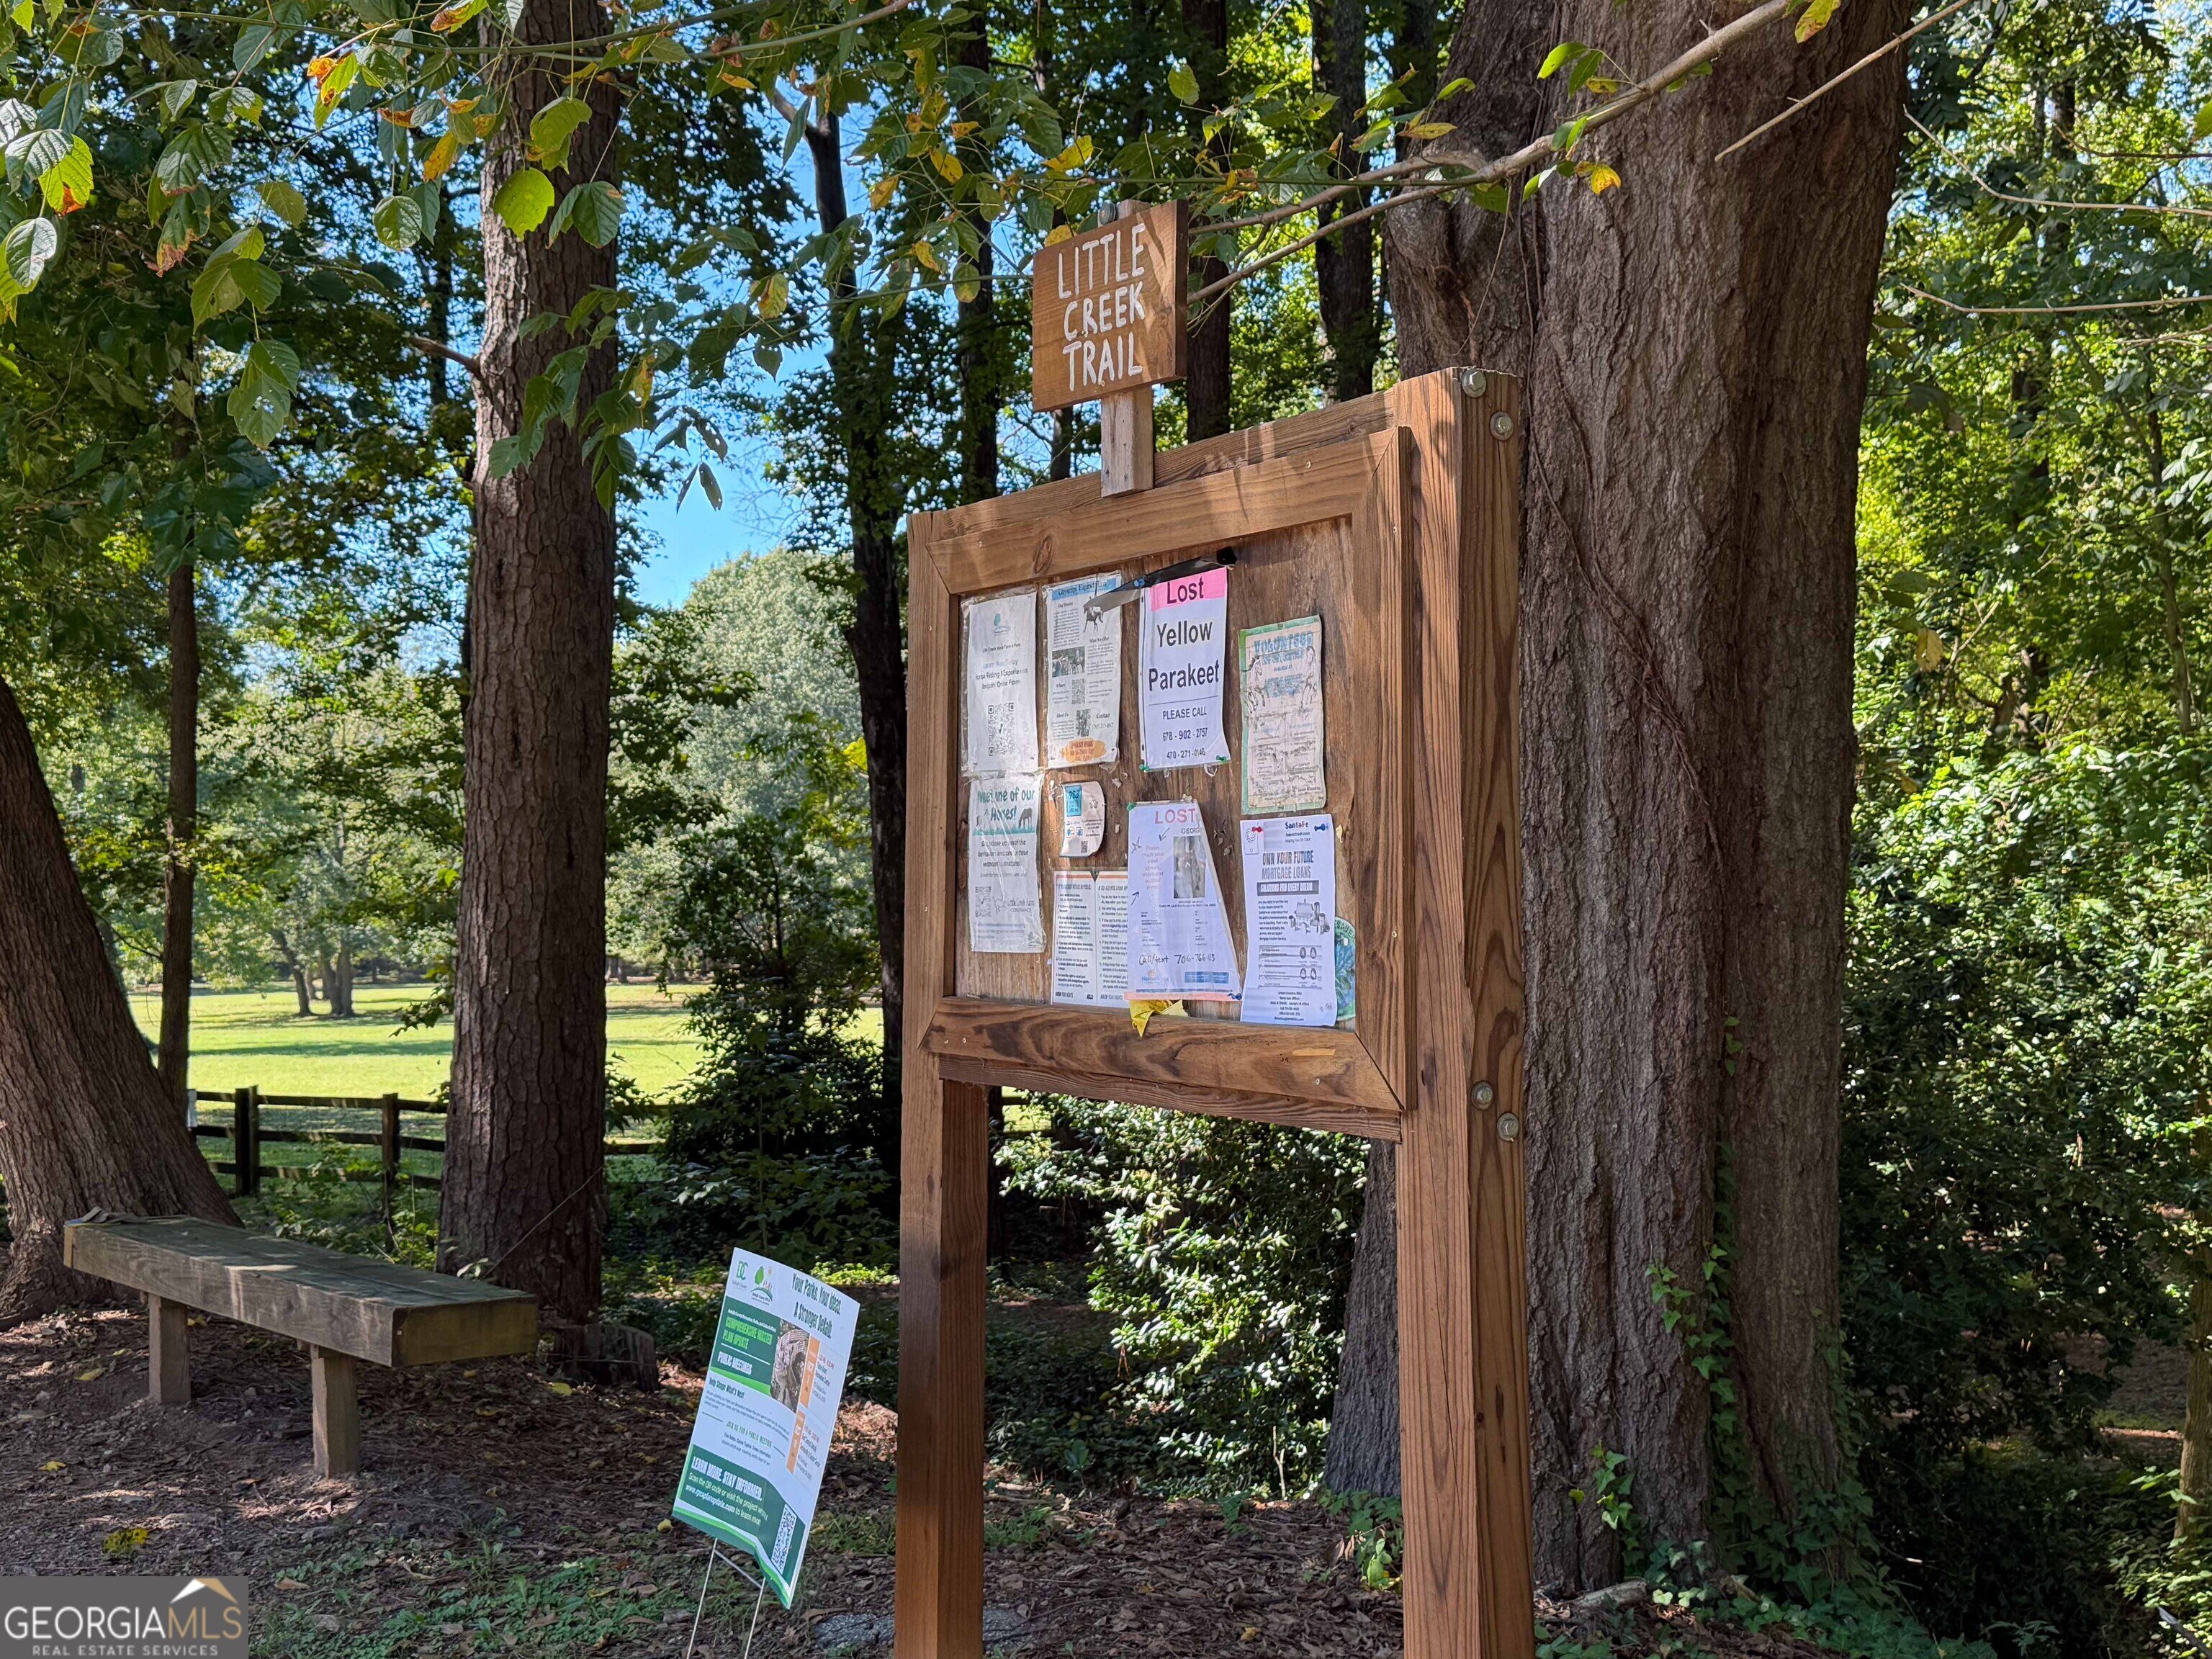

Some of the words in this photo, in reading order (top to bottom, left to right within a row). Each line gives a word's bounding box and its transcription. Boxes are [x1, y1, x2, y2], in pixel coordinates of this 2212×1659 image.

[1058, 223, 1146, 299] LITTLE
[1064, 281, 1145, 341] CREEK
[1063, 332, 1143, 391] TRAIL
[1167, 577, 1203, 603] Lost
[1157, 621, 1212, 647] Yellow
[1149, 659, 1219, 691] Parakeet
[1163, 709, 1190, 719] PLEASE
[1192, 706, 1207, 716] CALL
[1179, 730, 1191, 739] 902
[1010, 786, 1019, 801] of
[1022, 789, 1035, 801] our
[1155, 809, 1195, 824] LOST
[1263, 853, 1274, 865] OWN
[1277, 852, 1292, 864] YOUR
[1294, 850, 1314, 863] FUTURE
[1262, 866, 1291, 879] MORTGAGE
[1293, 866, 1310, 878] LOANS
[1139, 954, 1169, 965] Call/text
[793, 1273, 804, 1293] Your
[804, 1279, 817, 1301] Parks.
[817, 1286, 830, 1307] Your
[793, 1302, 799, 1318] A
[798, 1304, 817, 1328] Stronger
[691, 1456, 709, 1475] LEARN
[722, 1471, 737, 1488] STAY
[735, 1477, 763, 1501] INFORMED.
[689, 1473, 698, 1483] Scan
[706, 1480, 711, 1489] QR
[711, 1485, 721, 1494] code
[727, 1491, 736, 1501] visit
[743, 1499, 758, 1511] project
